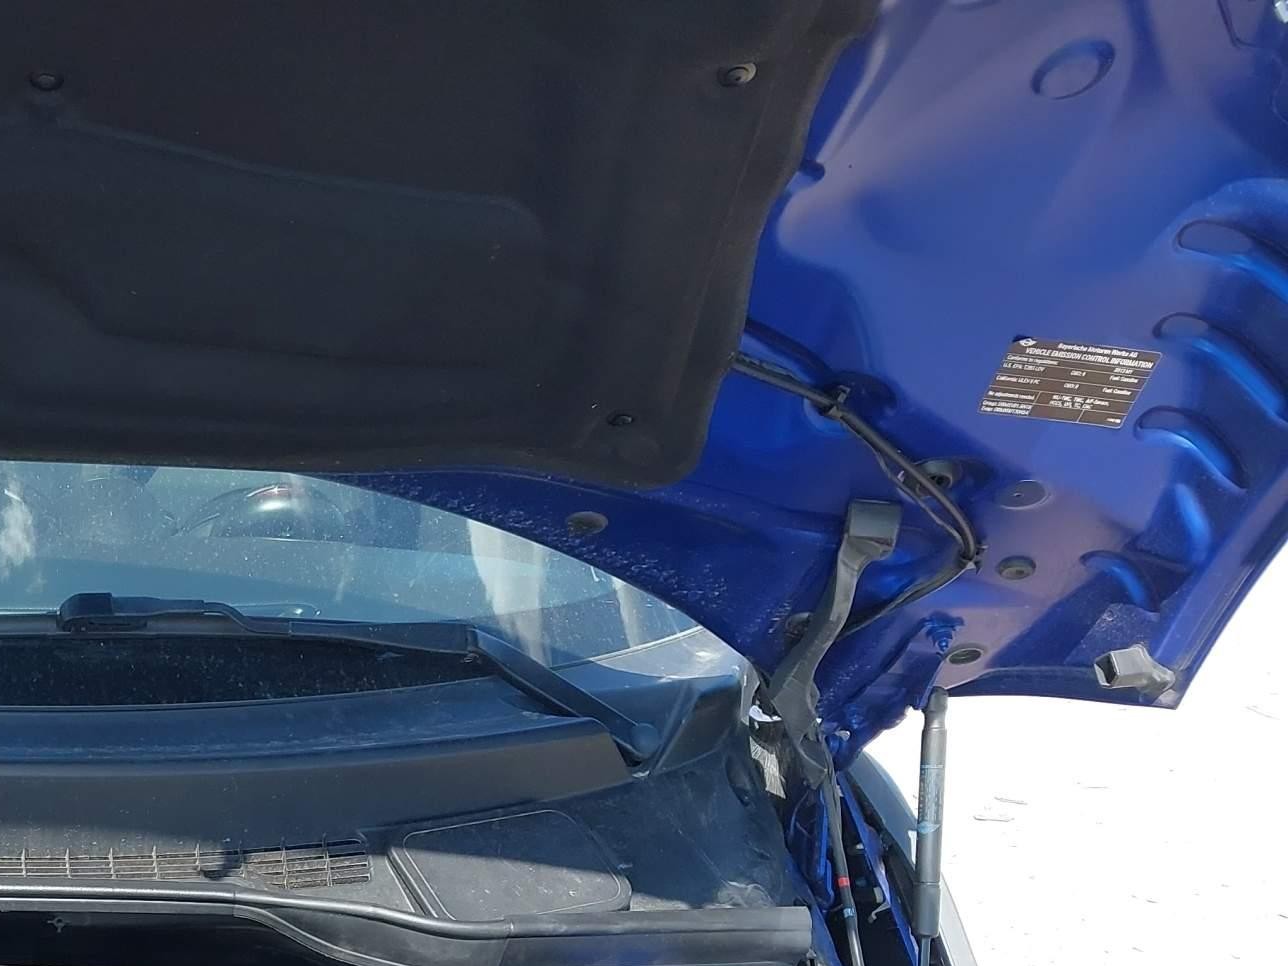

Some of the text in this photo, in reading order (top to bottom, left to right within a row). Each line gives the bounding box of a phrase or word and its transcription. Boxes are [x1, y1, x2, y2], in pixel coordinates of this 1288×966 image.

[1025, 348, 1154, 368] VEHICLE EMISSION CONTROL INFORMATION
